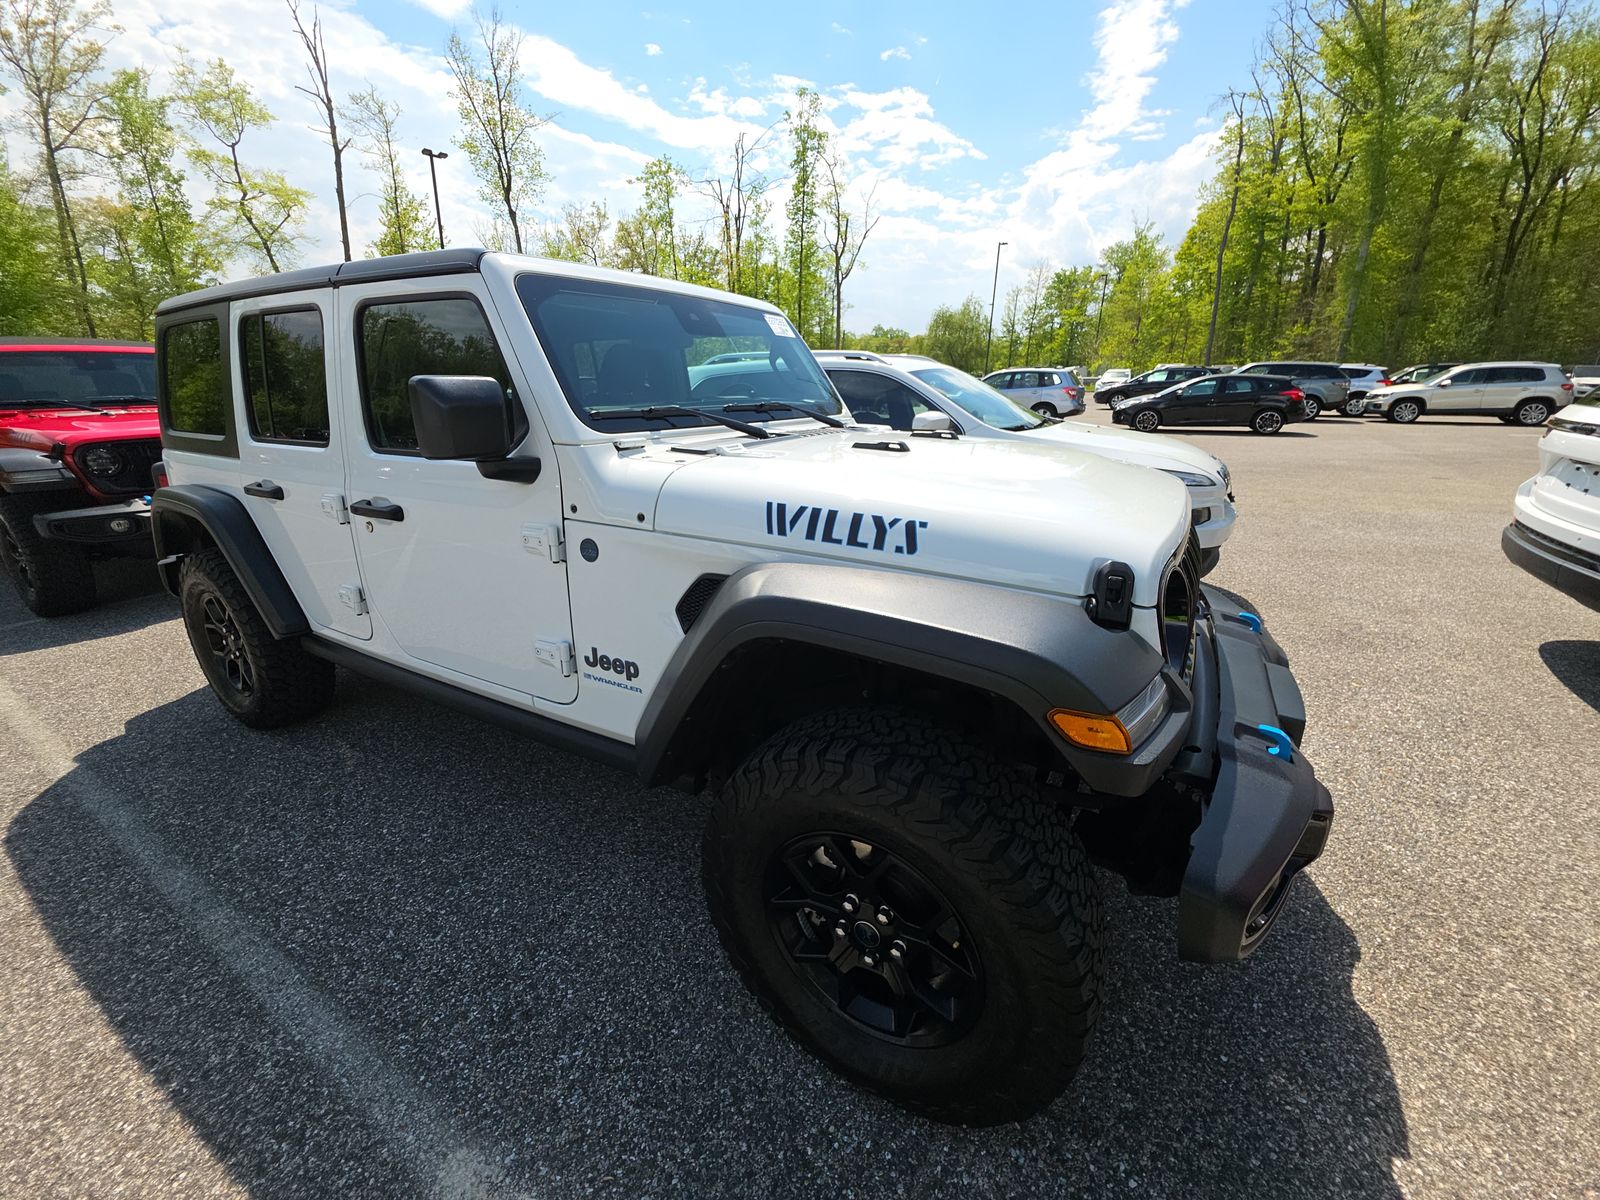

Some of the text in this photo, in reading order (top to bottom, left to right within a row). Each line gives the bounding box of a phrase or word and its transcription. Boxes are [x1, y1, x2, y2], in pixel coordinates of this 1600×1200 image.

[766, 501, 928, 555] WILLYS
[584, 646, 640, 682] Jeep
[591, 675, 643, 694] WRANGLER
